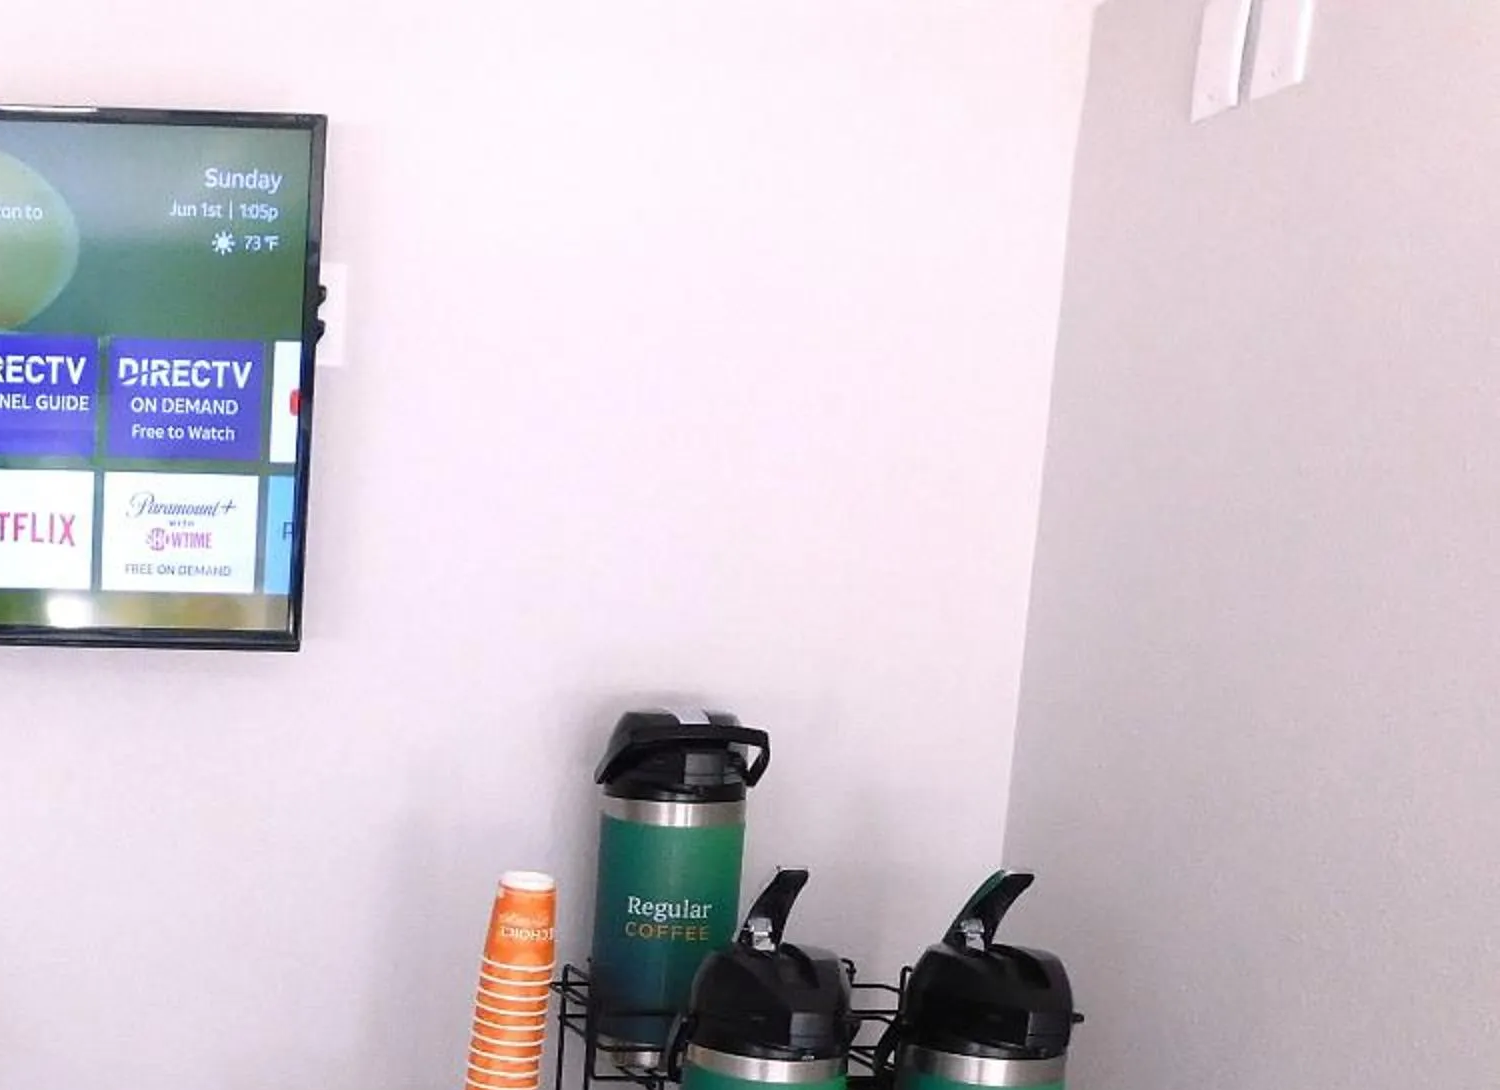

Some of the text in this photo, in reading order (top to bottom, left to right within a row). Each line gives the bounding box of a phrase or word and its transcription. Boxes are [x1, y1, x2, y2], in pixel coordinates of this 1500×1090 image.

[204, 167, 283, 195] Sunday
[25, 204, 43, 220] to
[169, 199, 197, 217] Jun
[201, 202, 222, 218] 1st
[243, 235, 261, 251] 73
[118, 357, 252, 389] DIRECTV
[35, 394, 90, 412] GUIDE
[131, 397, 239, 415] ON DEMAND
[131, 424, 235, 441] Free to Watch
[125, 563, 232, 577] FREE ON DEMAND
[627, 896, 712, 922] Regular
[625, 921, 709, 942] COFFEE
